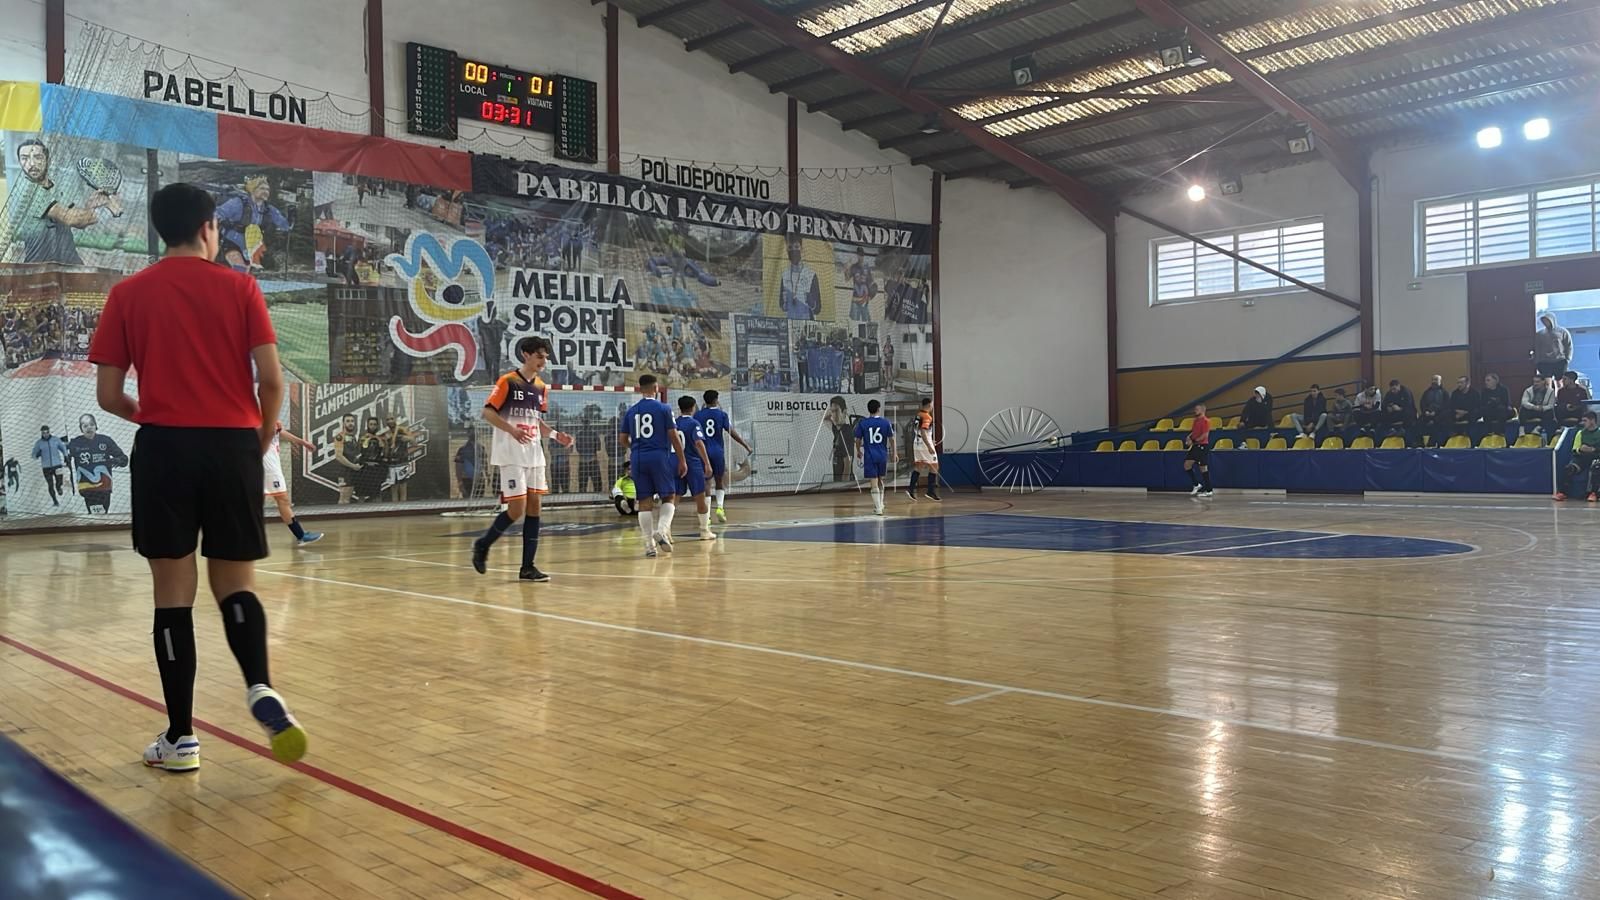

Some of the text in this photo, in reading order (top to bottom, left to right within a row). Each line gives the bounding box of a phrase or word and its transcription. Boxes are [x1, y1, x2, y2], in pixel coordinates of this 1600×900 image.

[460, 83, 488, 97] LOCAL
[465, 62, 553, 96] 00 01
[507, 81, 512, 93] 1
[143, 70, 307, 124] PABELLON
[527, 97, 553, 110] VISITANTE
[482, 101, 532, 126] 03:31
[641, 158, 770, 200] POLIDEPORTIVO
[516, 171, 913, 249] PABELLÓN LÁZARO FERNÁNDEZ
[512, 270, 633, 306] MELILLA
[514, 304, 612, 335] SPORT
[767, 401, 828, 411] URI BOTELLO
[634, 413, 654, 439] 18
[705, 418, 716, 438] 8
[868, 426, 883, 444] 16
